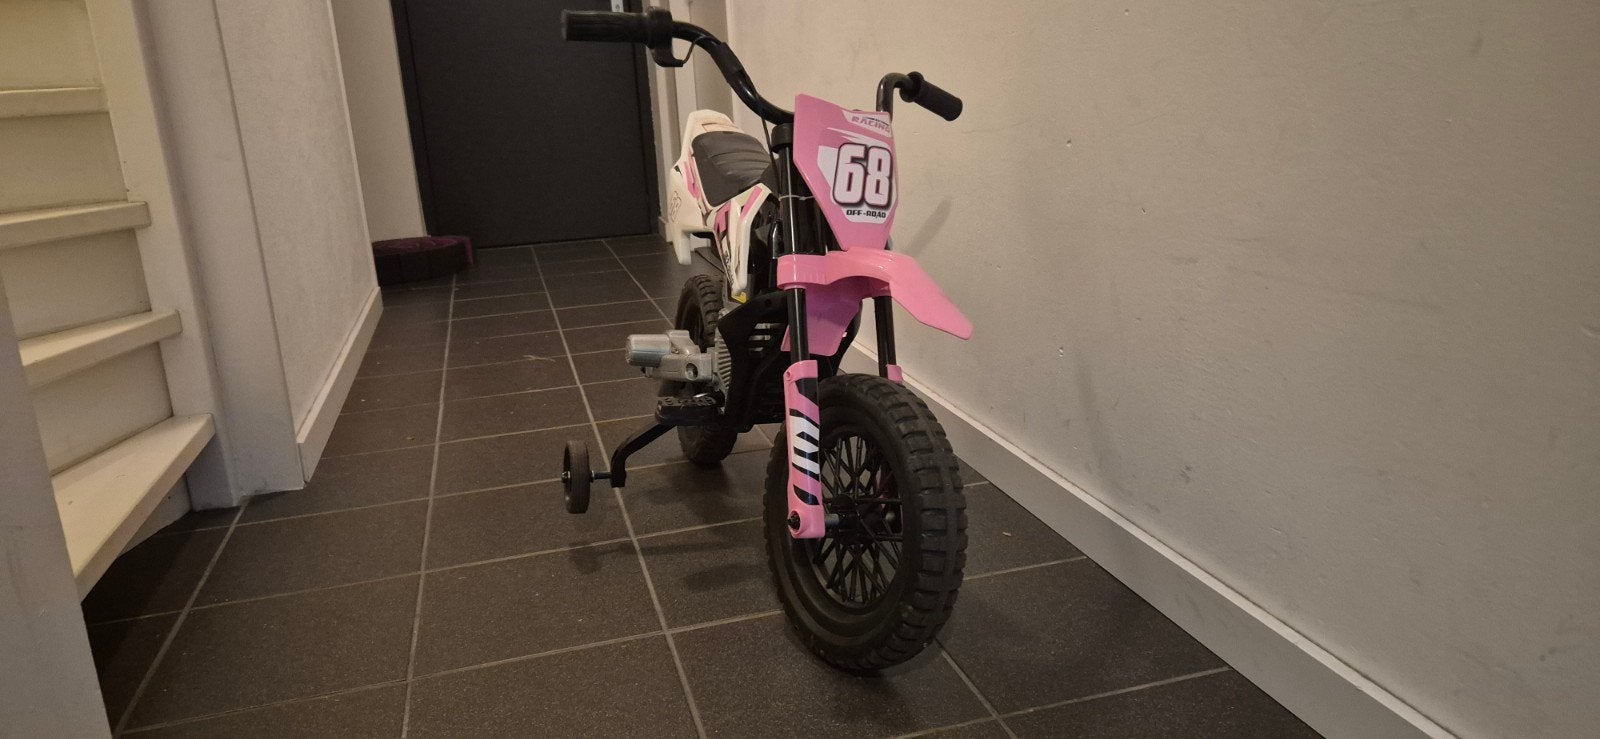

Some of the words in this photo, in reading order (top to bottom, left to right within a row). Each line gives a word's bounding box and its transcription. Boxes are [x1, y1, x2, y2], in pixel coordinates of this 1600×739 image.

[851, 116, 890, 133] RACING
[833, 142, 893, 208] 68
[846, 209, 886, 218] OFF-ROAD
